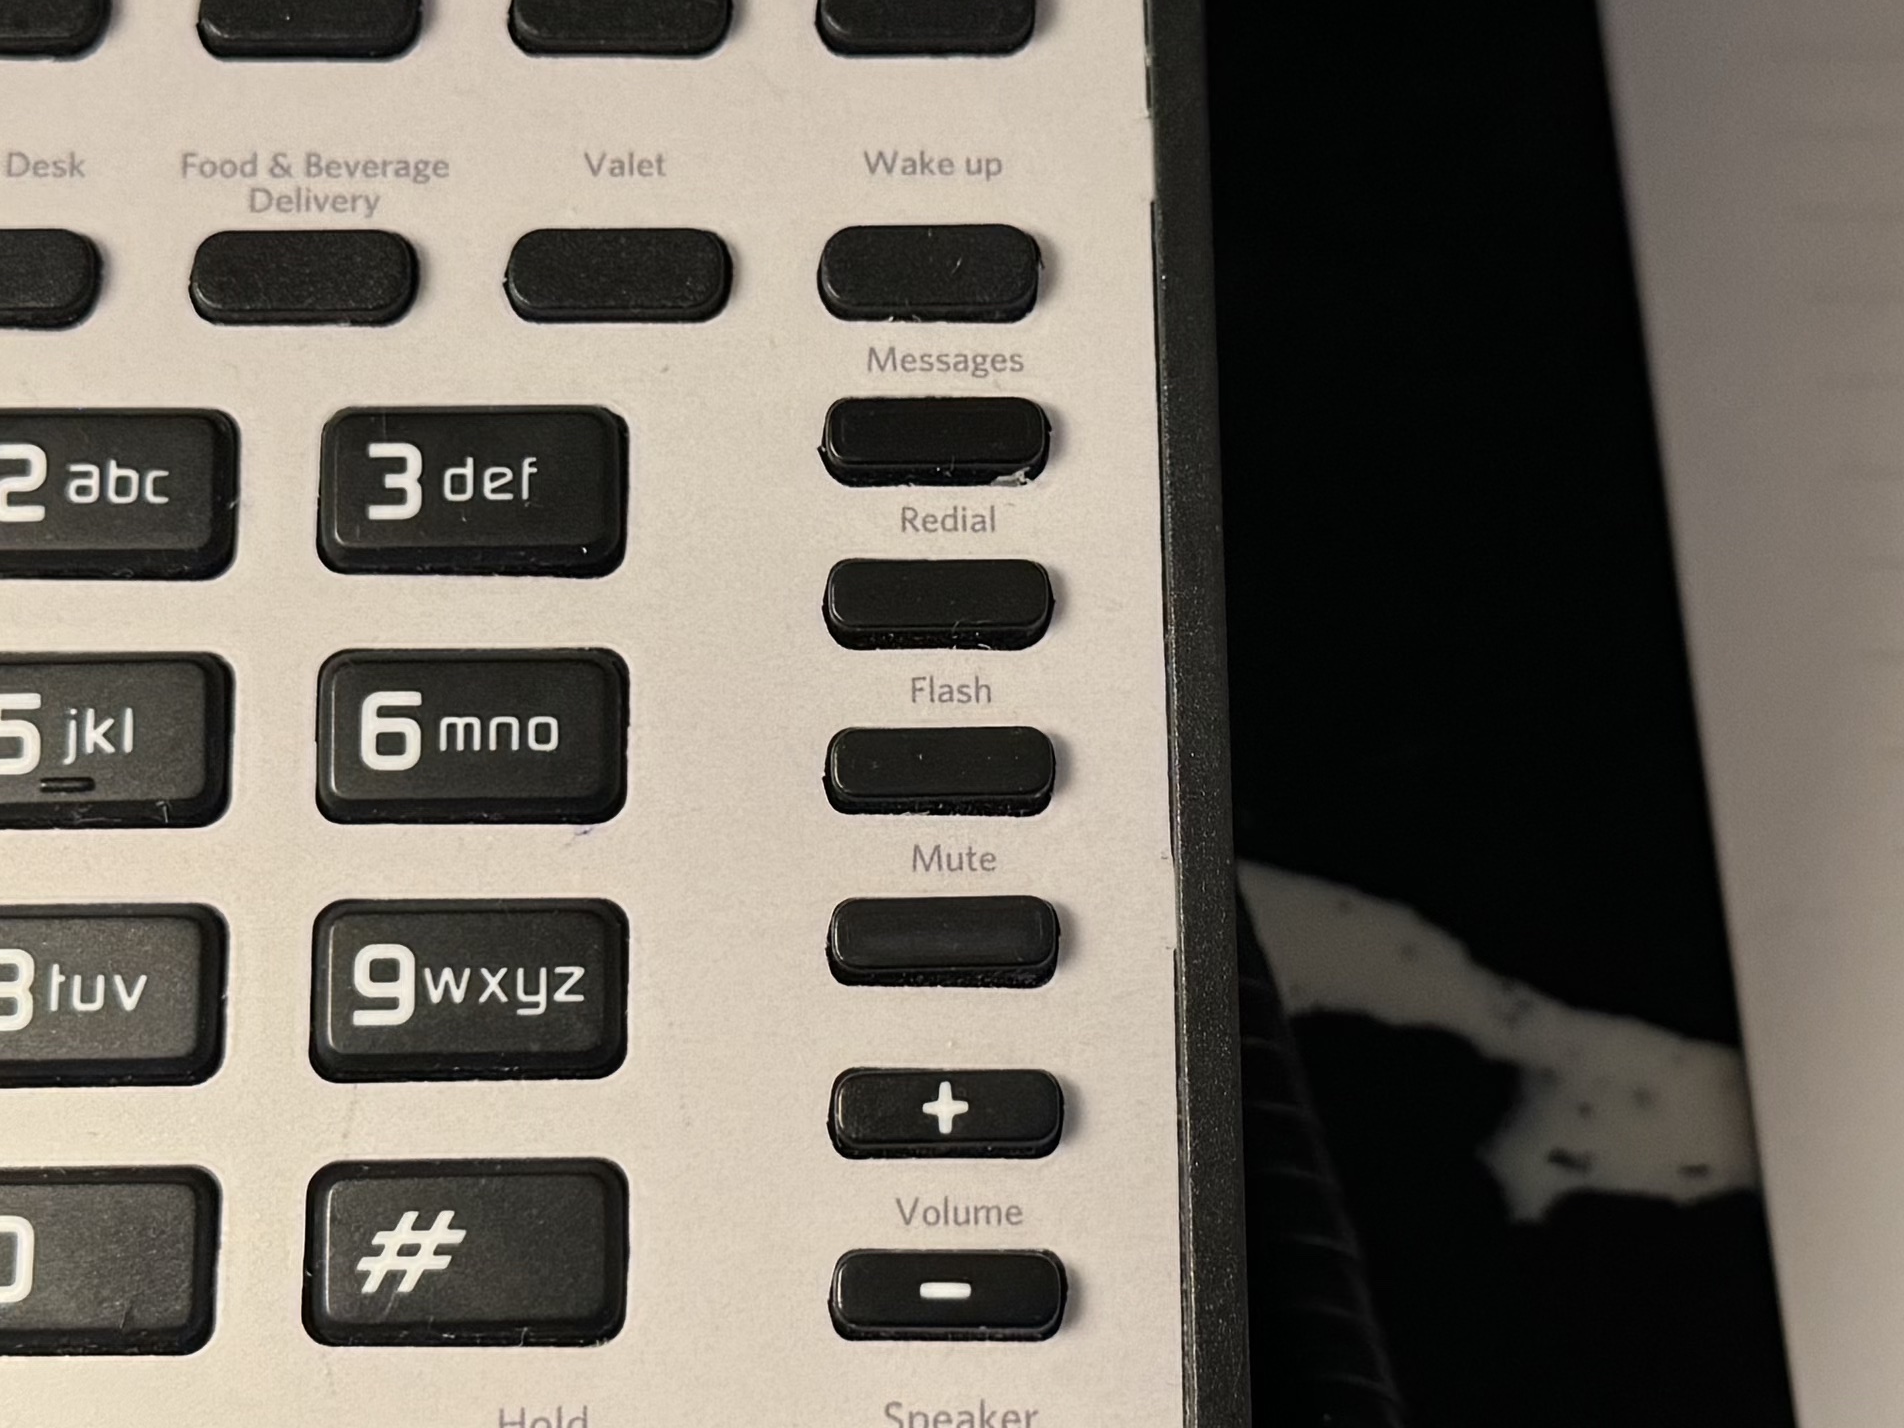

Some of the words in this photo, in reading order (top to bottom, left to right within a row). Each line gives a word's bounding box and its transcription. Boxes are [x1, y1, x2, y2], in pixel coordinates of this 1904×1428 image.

[6, 152, 86, 178] Desk
[181, 152, 258, 179] Food
[268, 153, 292, 179] &
[304, 152, 449, 185] Beverage
[584, 152, 666, 177] Valet
[864, 150, 955, 177] Wake
[965, 157, 1003, 184] up
[248, 187, 380, 217] Delivery
[867, 346, 1024, 379] Messages
[67, 458, 170, 505] abc
[367, 442, 423, 520] 3
[443, 456, 538, 502] def
[900, 507, 996, 533] Redial
[911, 677, 993, 705] Flash
[63, 708, 134, 766] jkl
[361, 691, 422, 771] 6
[439, 716, 559, 752] mno
[912, 846, 997, 873] Mute
[48, 964, 147, 1012] tuv
[353, 944, 416, 1025] 9
[424, 966, 586, 1016] wxyz
[896, 1196, 1024, 1228] Volume
[357, 1210, 466, 1294] #
